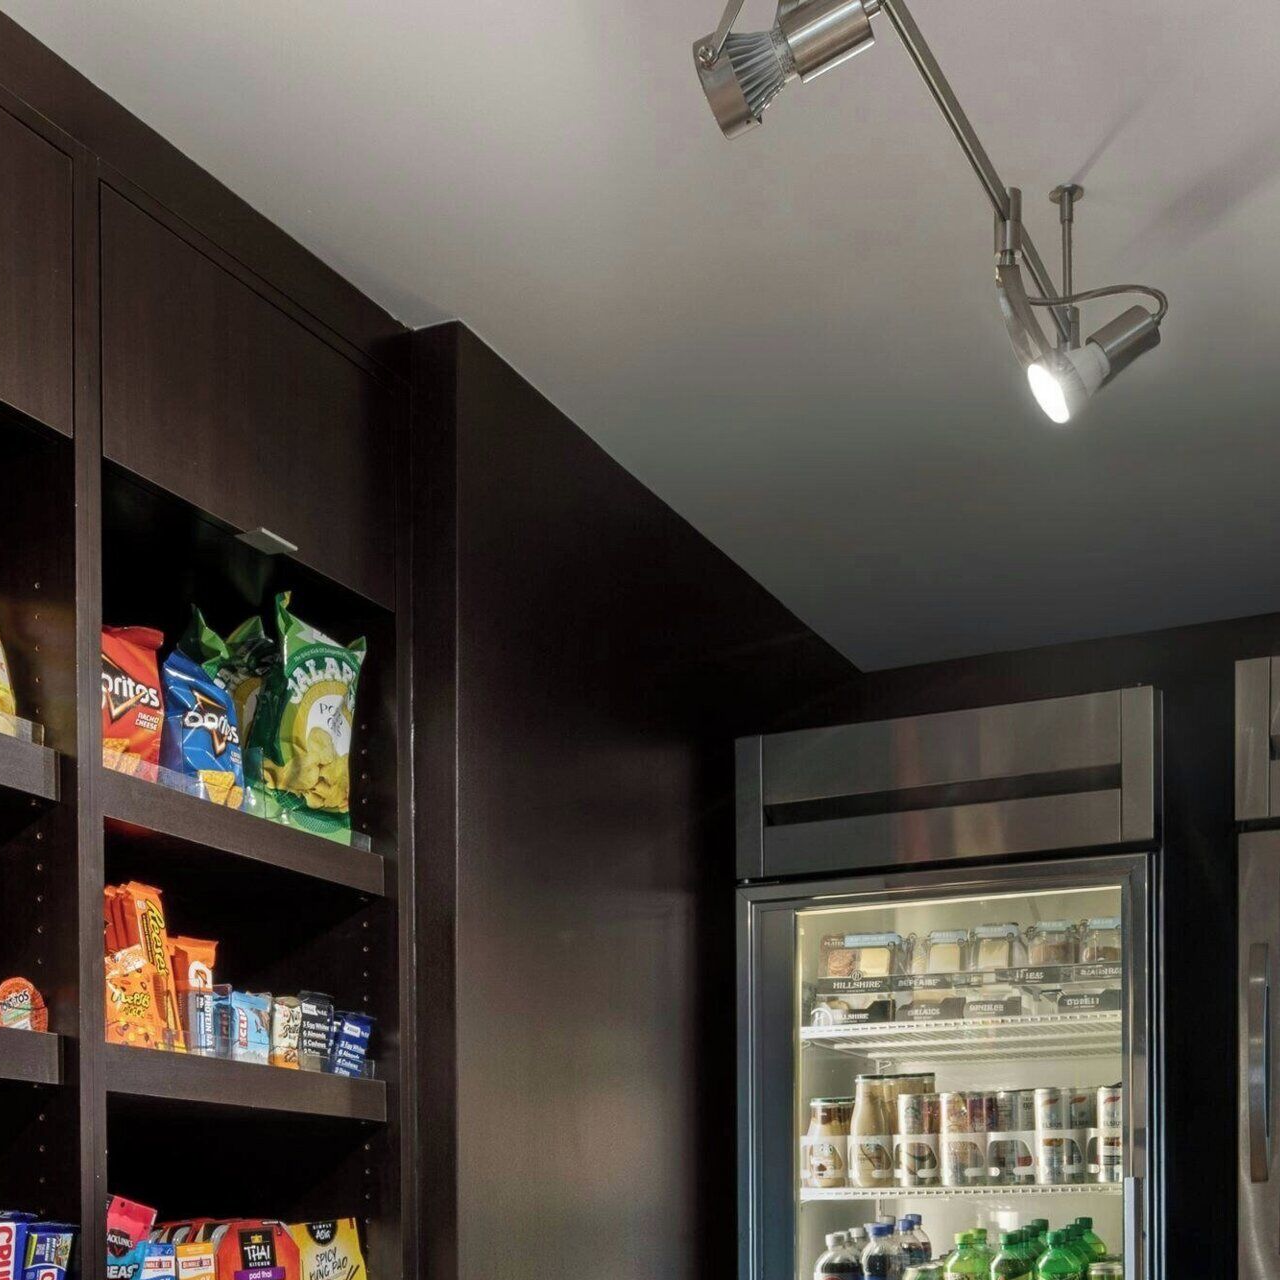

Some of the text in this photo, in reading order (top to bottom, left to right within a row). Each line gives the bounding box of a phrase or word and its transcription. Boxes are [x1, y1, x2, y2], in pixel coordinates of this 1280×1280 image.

[102, 672, 160, 708] oritos
[145, 899, 169, 977] Reese's
[833, 980, 882, 990] HILLSHIRE
[243, 1244, 271, 1262] THAI
[315, 1247, 338, 1268] SPICY
